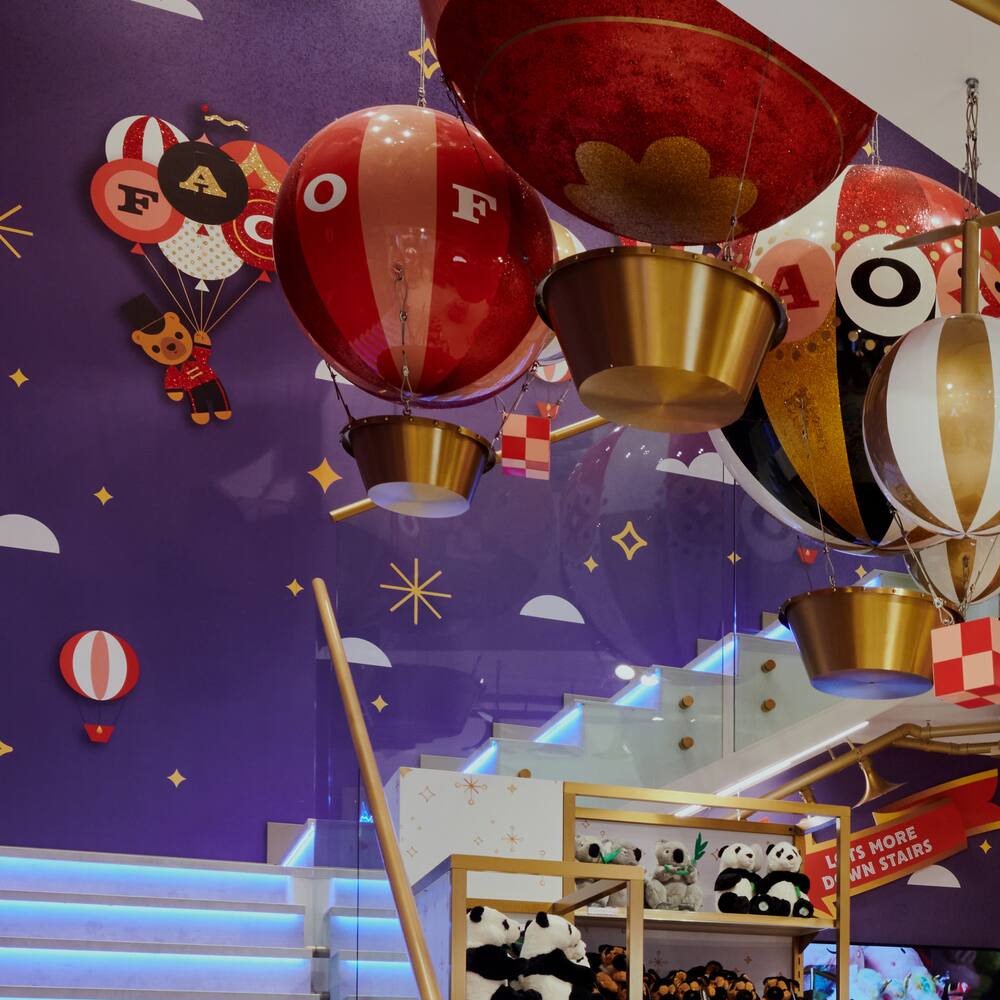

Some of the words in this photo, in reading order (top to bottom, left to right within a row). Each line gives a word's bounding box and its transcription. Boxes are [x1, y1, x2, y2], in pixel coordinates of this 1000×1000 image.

[118, 184, 158, 215] F
[179, 164, 227, 198] A
[304, 173, 346, 212] O
[452, 183, 496, 224] F
[771, 264, 820, 310] A
[851, 257, 920, 307] O
[822, 862, 876, 890] DWN
[878, 838, 933, 871] STAIRS
[824, 844, 866, 870] LTS
[868, 826, 918, 855] MORE
